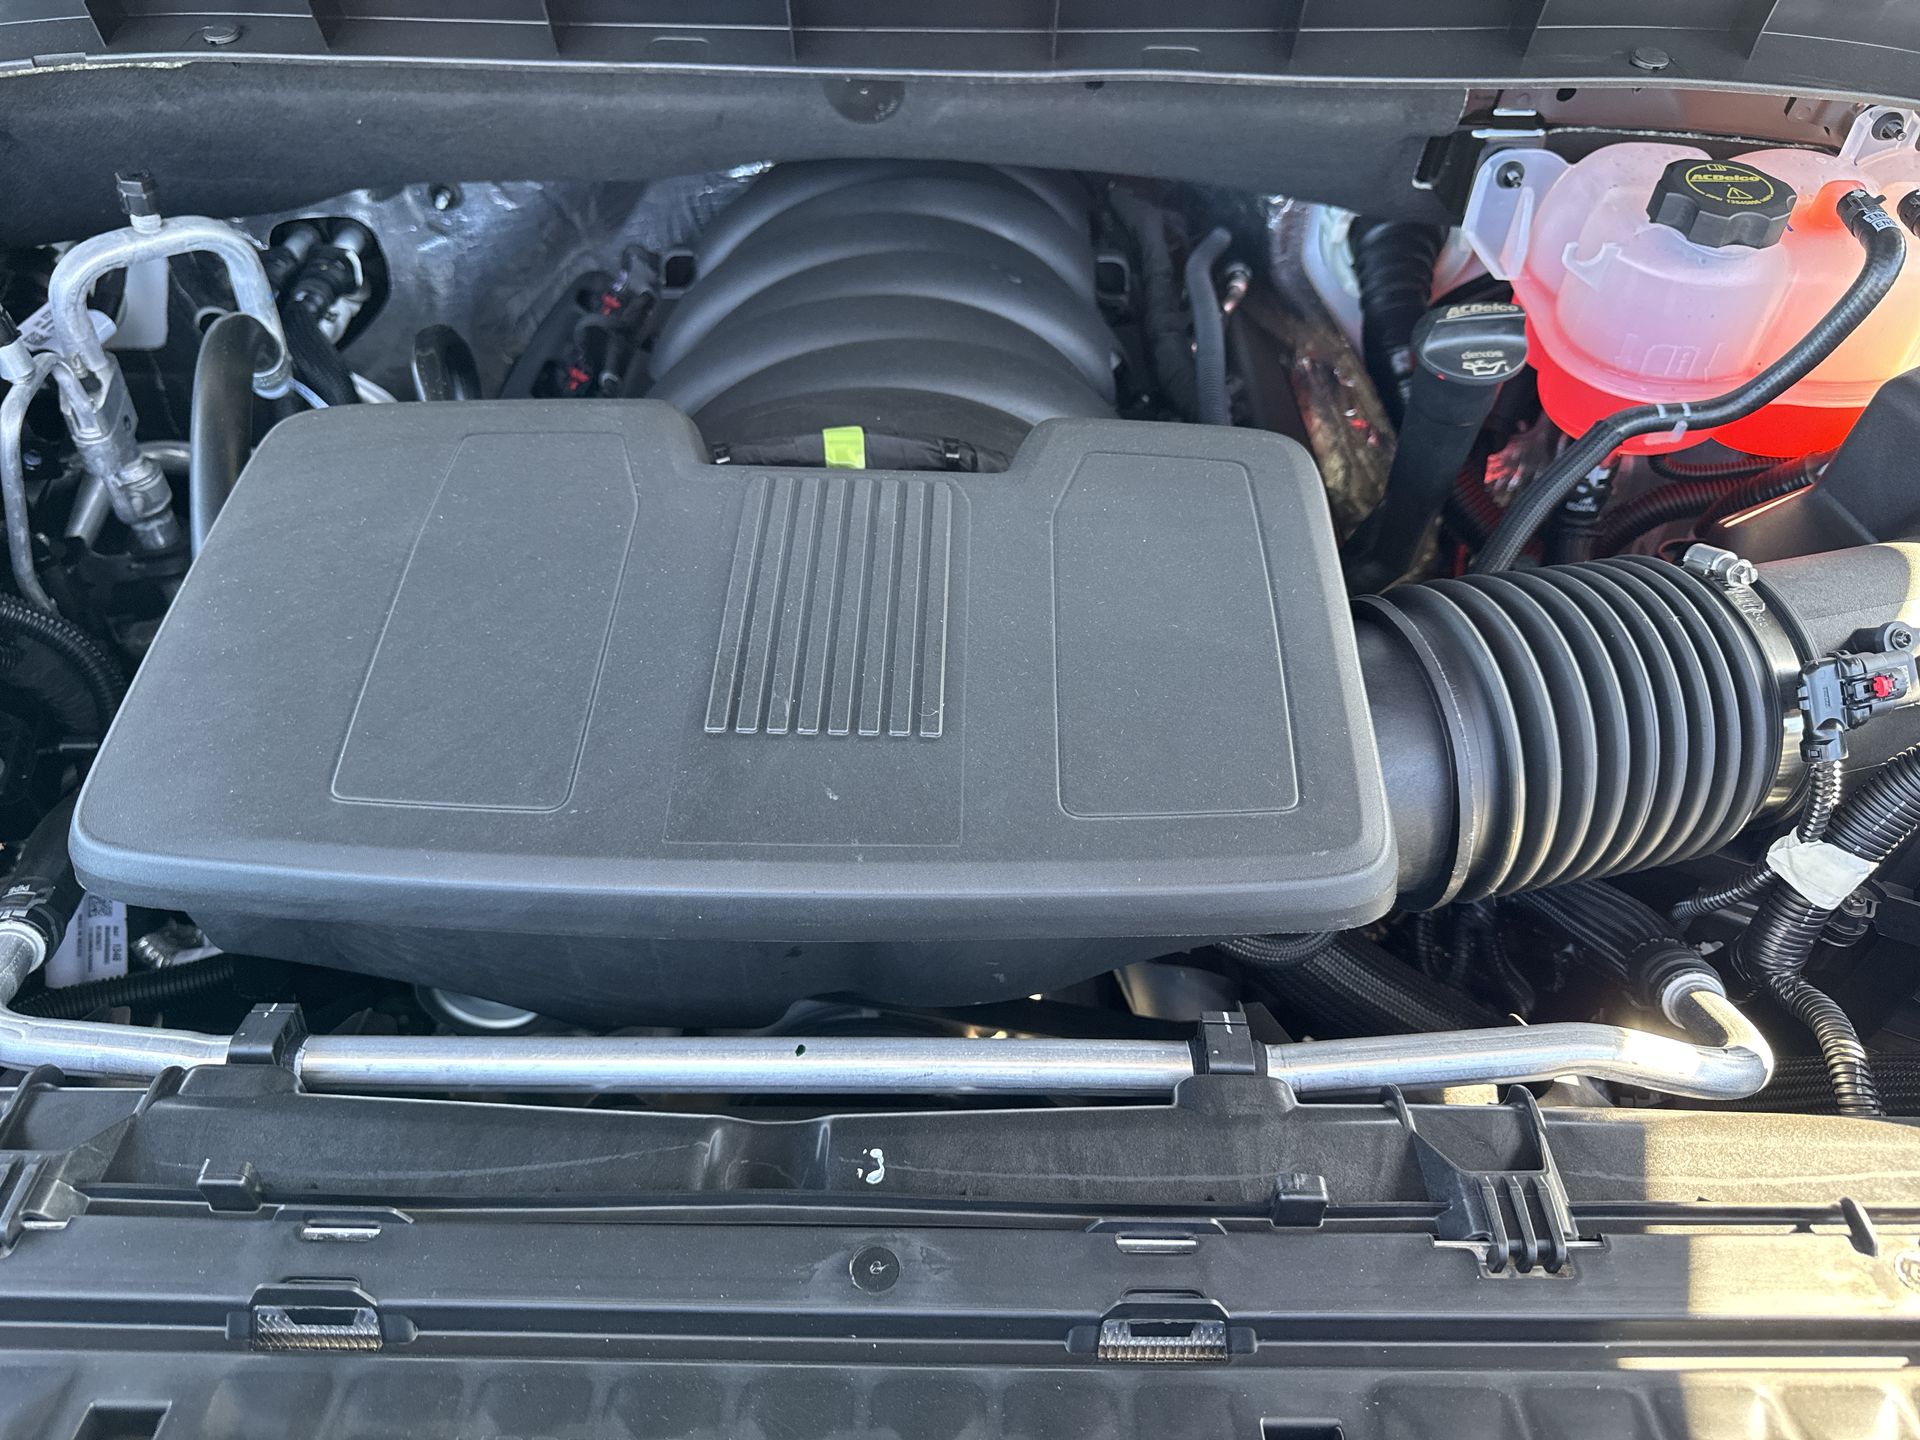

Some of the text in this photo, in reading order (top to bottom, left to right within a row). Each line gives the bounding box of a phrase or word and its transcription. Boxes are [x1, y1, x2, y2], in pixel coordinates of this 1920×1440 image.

[1690, 173, 1761, 182] ACDelco
[1446, 303, 1519, 319] ACDelco
[1461, 350, 1504, 360] dexos
